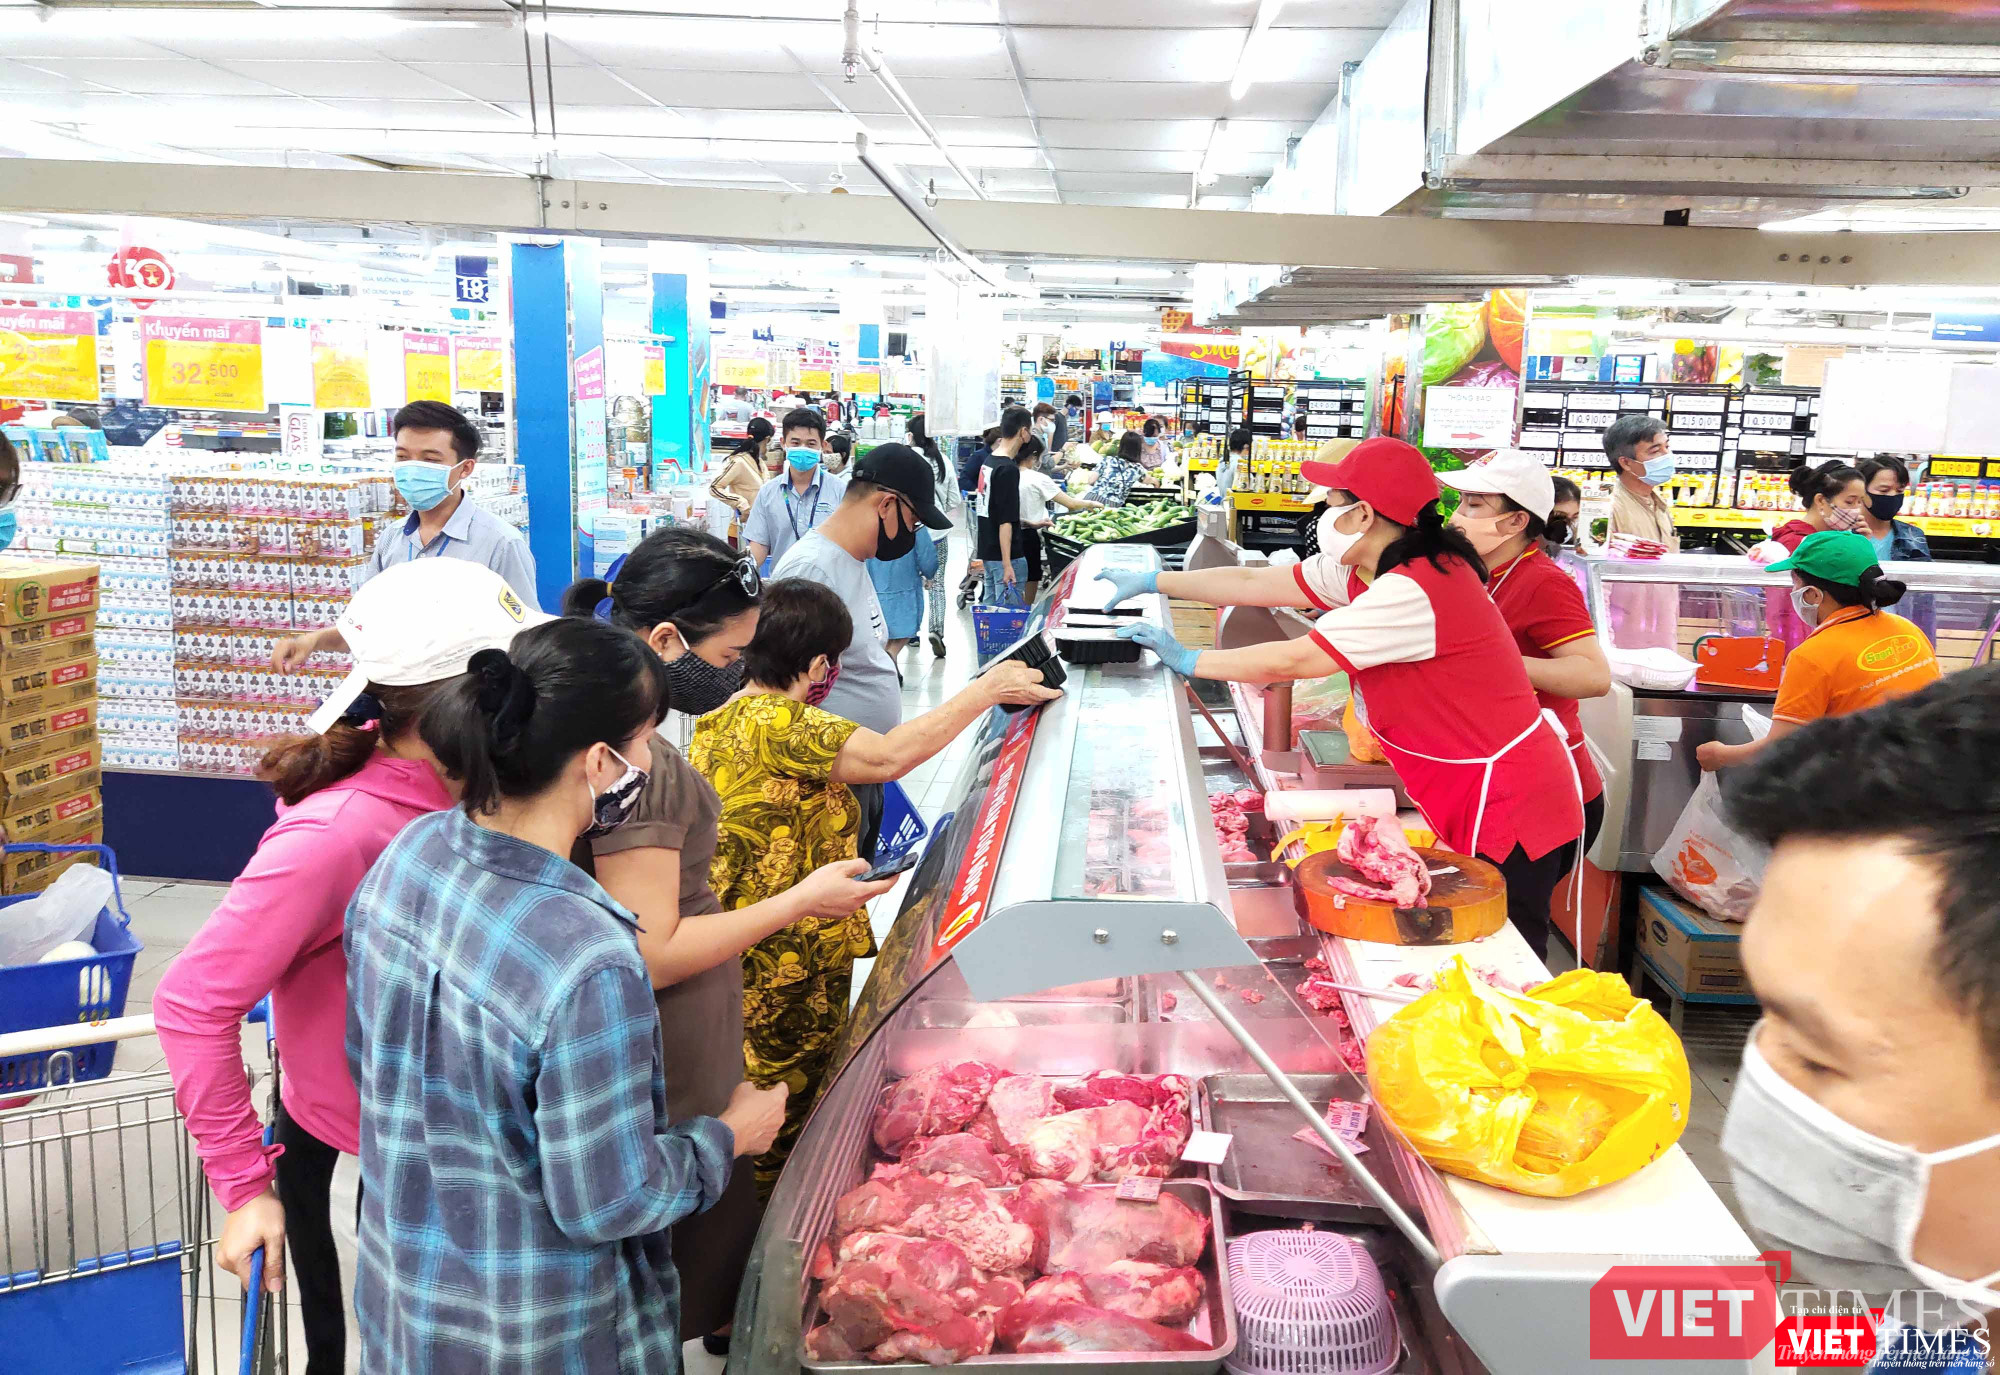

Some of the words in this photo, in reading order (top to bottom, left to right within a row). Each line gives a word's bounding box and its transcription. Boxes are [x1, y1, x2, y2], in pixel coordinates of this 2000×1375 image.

[145, 320, 200, 340] Khuyến
[203, 322, 230, 339] mãi
[172, 362, 239, 385] 32.500
